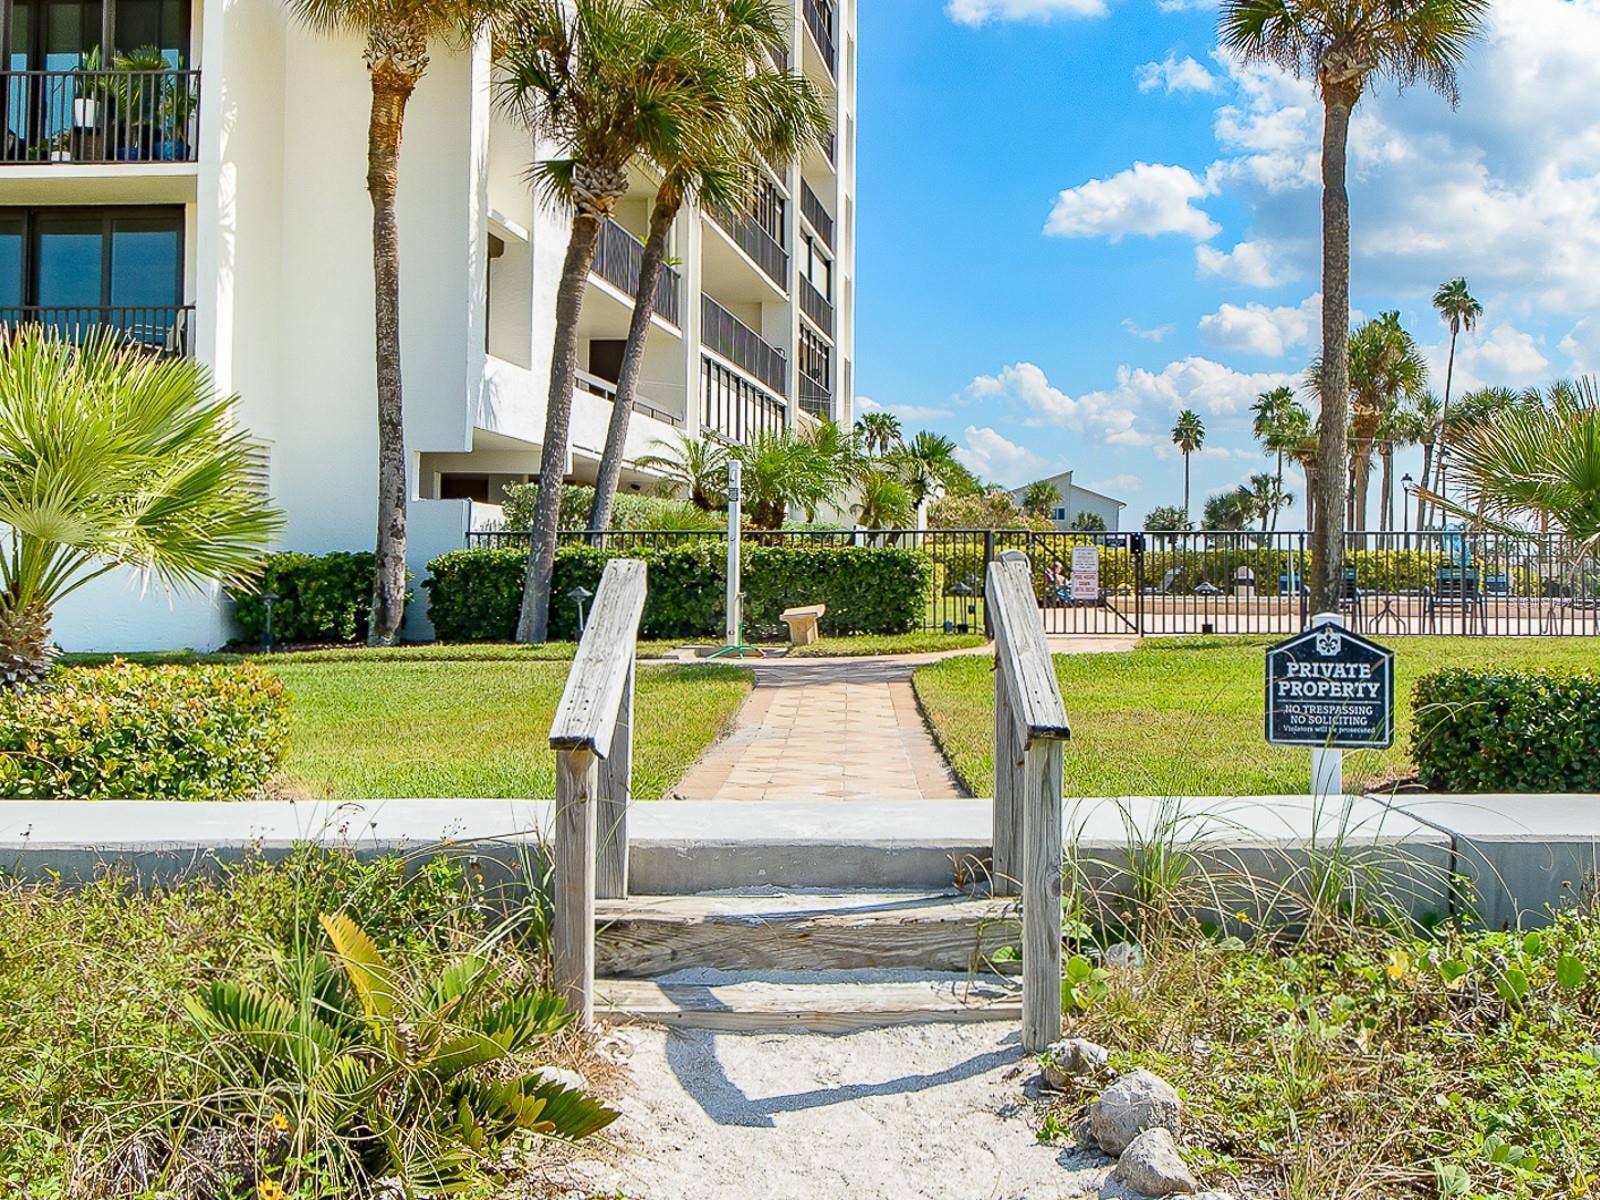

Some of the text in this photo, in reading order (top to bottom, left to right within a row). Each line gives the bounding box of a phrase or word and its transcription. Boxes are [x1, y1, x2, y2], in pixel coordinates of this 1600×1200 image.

[1286, 662, 1371, 678] PRIVATE
[1278, 681, 1380, 697] PROPERTY
[1285, 704, 1373, 716] NO TRESPASSING
[1290, 715, 1368, 726] NO SOLICITING
[1283, 725, 1314, 734] Violators
[1315, 725, 1327, 733] will
